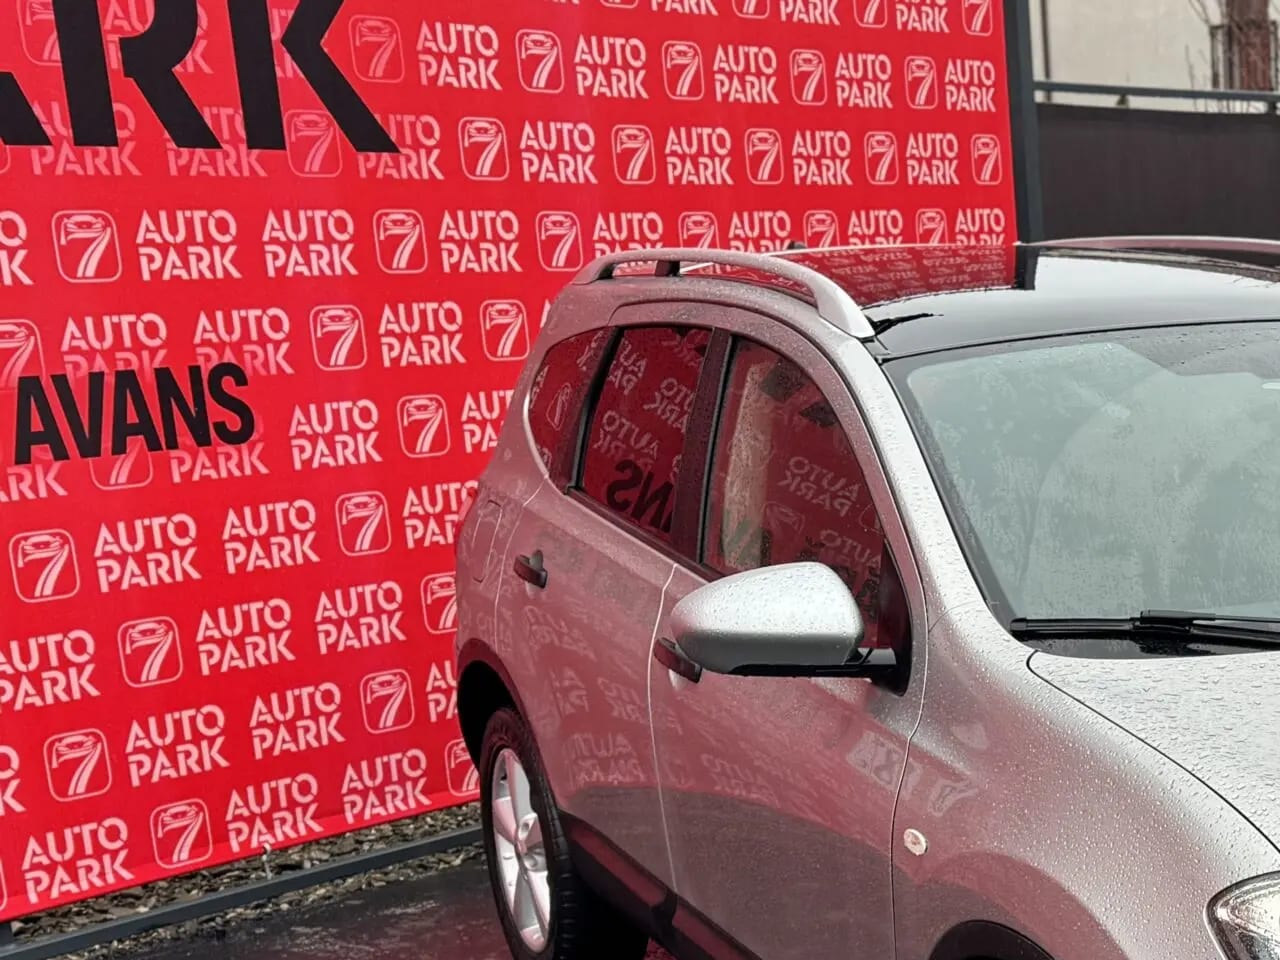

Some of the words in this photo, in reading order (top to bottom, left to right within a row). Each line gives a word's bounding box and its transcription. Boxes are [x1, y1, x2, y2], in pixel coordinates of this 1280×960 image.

[779, 0, 841, 26] PARK
[895, 3, 950, 34] PARK
[416, 21, 499, 57] AUTO
[573, 34, 647, 68] AUTO
[418, 53, 503, 91] PARK
[712, 43, 777, 75] AUTO
[834, 52, 892, 81] AUTO
[944, 58, 996, 87] AUTO
[575, 65, 649, 100] PARK
[714, 73, 780, 105] PARK
[835, 79, 893, 109] PARK
[945, 84, 996, 113] PARK
[519, 120, 596, 153] AUTO
[664, 126, 732, 156] AUTO
[791, 129, 851, 158] AUTO
[905, 132, 959, 159] AUTO
[31, 141, 142, 176] PARK
[166, 142, 268, 177] PARK
[357, 147, 445, 180] PARK
[521, 151, 599, 185] PARK
[666, 156, 734, 186] PARK
[792, 157, 853, 186] PARK
[906, 158, 960, 185] PARK
[135, 209, 238, 245] AUTO
[261, 208, 355, 242] AUTO
[438, 209, 520, 241] AUTO
[592, 211, 664, 241] AUTO
[727, 210, 792, 239] AUTO
[847, 208, 904, 236] AUTO
[954, 207, 1006, 233] AUTO
[138, 244, 243, 282] PARK
[263, 242, 359, 278] PARK
[440, 241, 523, 273] PARK
[60, 312, 168, 352] AUTO
[193, 307, 290, 345] AUTO
[378, 300, 463, 335] AUTO
[380, 332, 467, 368] PARK
[14, 361, 255, 465] AVANS
[288, 398, 379, 437] AUTO
[169, 442, 270, 484] PARK
[290, 431, 383, 471] PARK
[93, 513, 197, 558] AUTO
[221, 498, 316, 541] AUTO
[96, 546, 202, 593] PARK
[224, 530, 321, 575] PARK
[314, 580, 403, 623] AUTO
[195, 598, 292, 643] AUTO
[316, 610, 407, 655] PARK
[198, 629, 296, 676] PARK
[249, 682, 341, 728] AUTO
[124, 704, 225, 753] AUTO
[252, 712, 345, 760] PARK
[127, 736, 230, 787] PARK
[340, 748, 427, 795] AUTO
[225, 773, 318, 822] AUTO
[343, 777, 432, 824] PARK
[21, 817, 128, 870] AUTO
[227, 803, 324, 853] PARK
[24, 849, 134, 904] PARK
